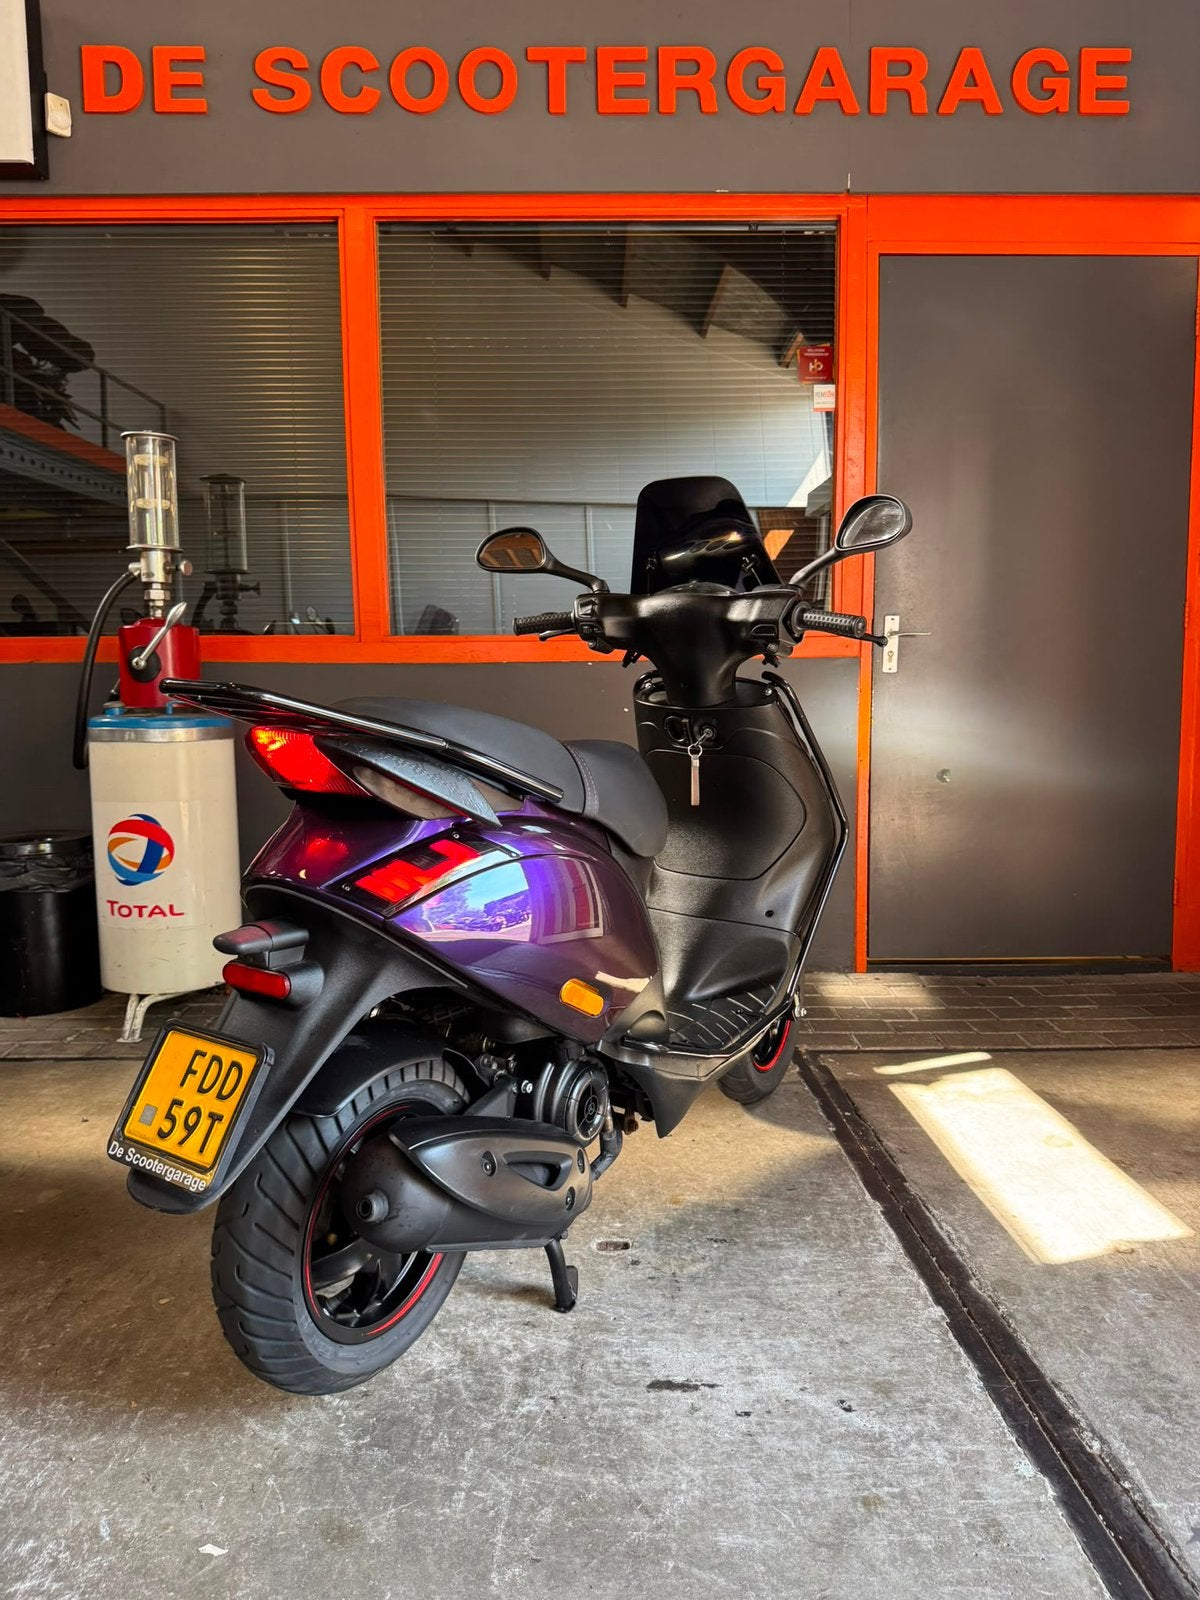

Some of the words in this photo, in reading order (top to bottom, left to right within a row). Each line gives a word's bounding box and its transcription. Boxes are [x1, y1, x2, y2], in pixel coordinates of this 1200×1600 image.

[82, 45, 207, 112] DE
[253, 46, 1131, 115] SCOOTERGARAGE
[106, 900, 185, 918] TOTAL
[180, 1049, 243, 1101] FDD
[157, 1098, 224, 1154] 59T
[108, 1141, 124, 1158] De
[125, 1148, 207, 1192] Scootergarage
